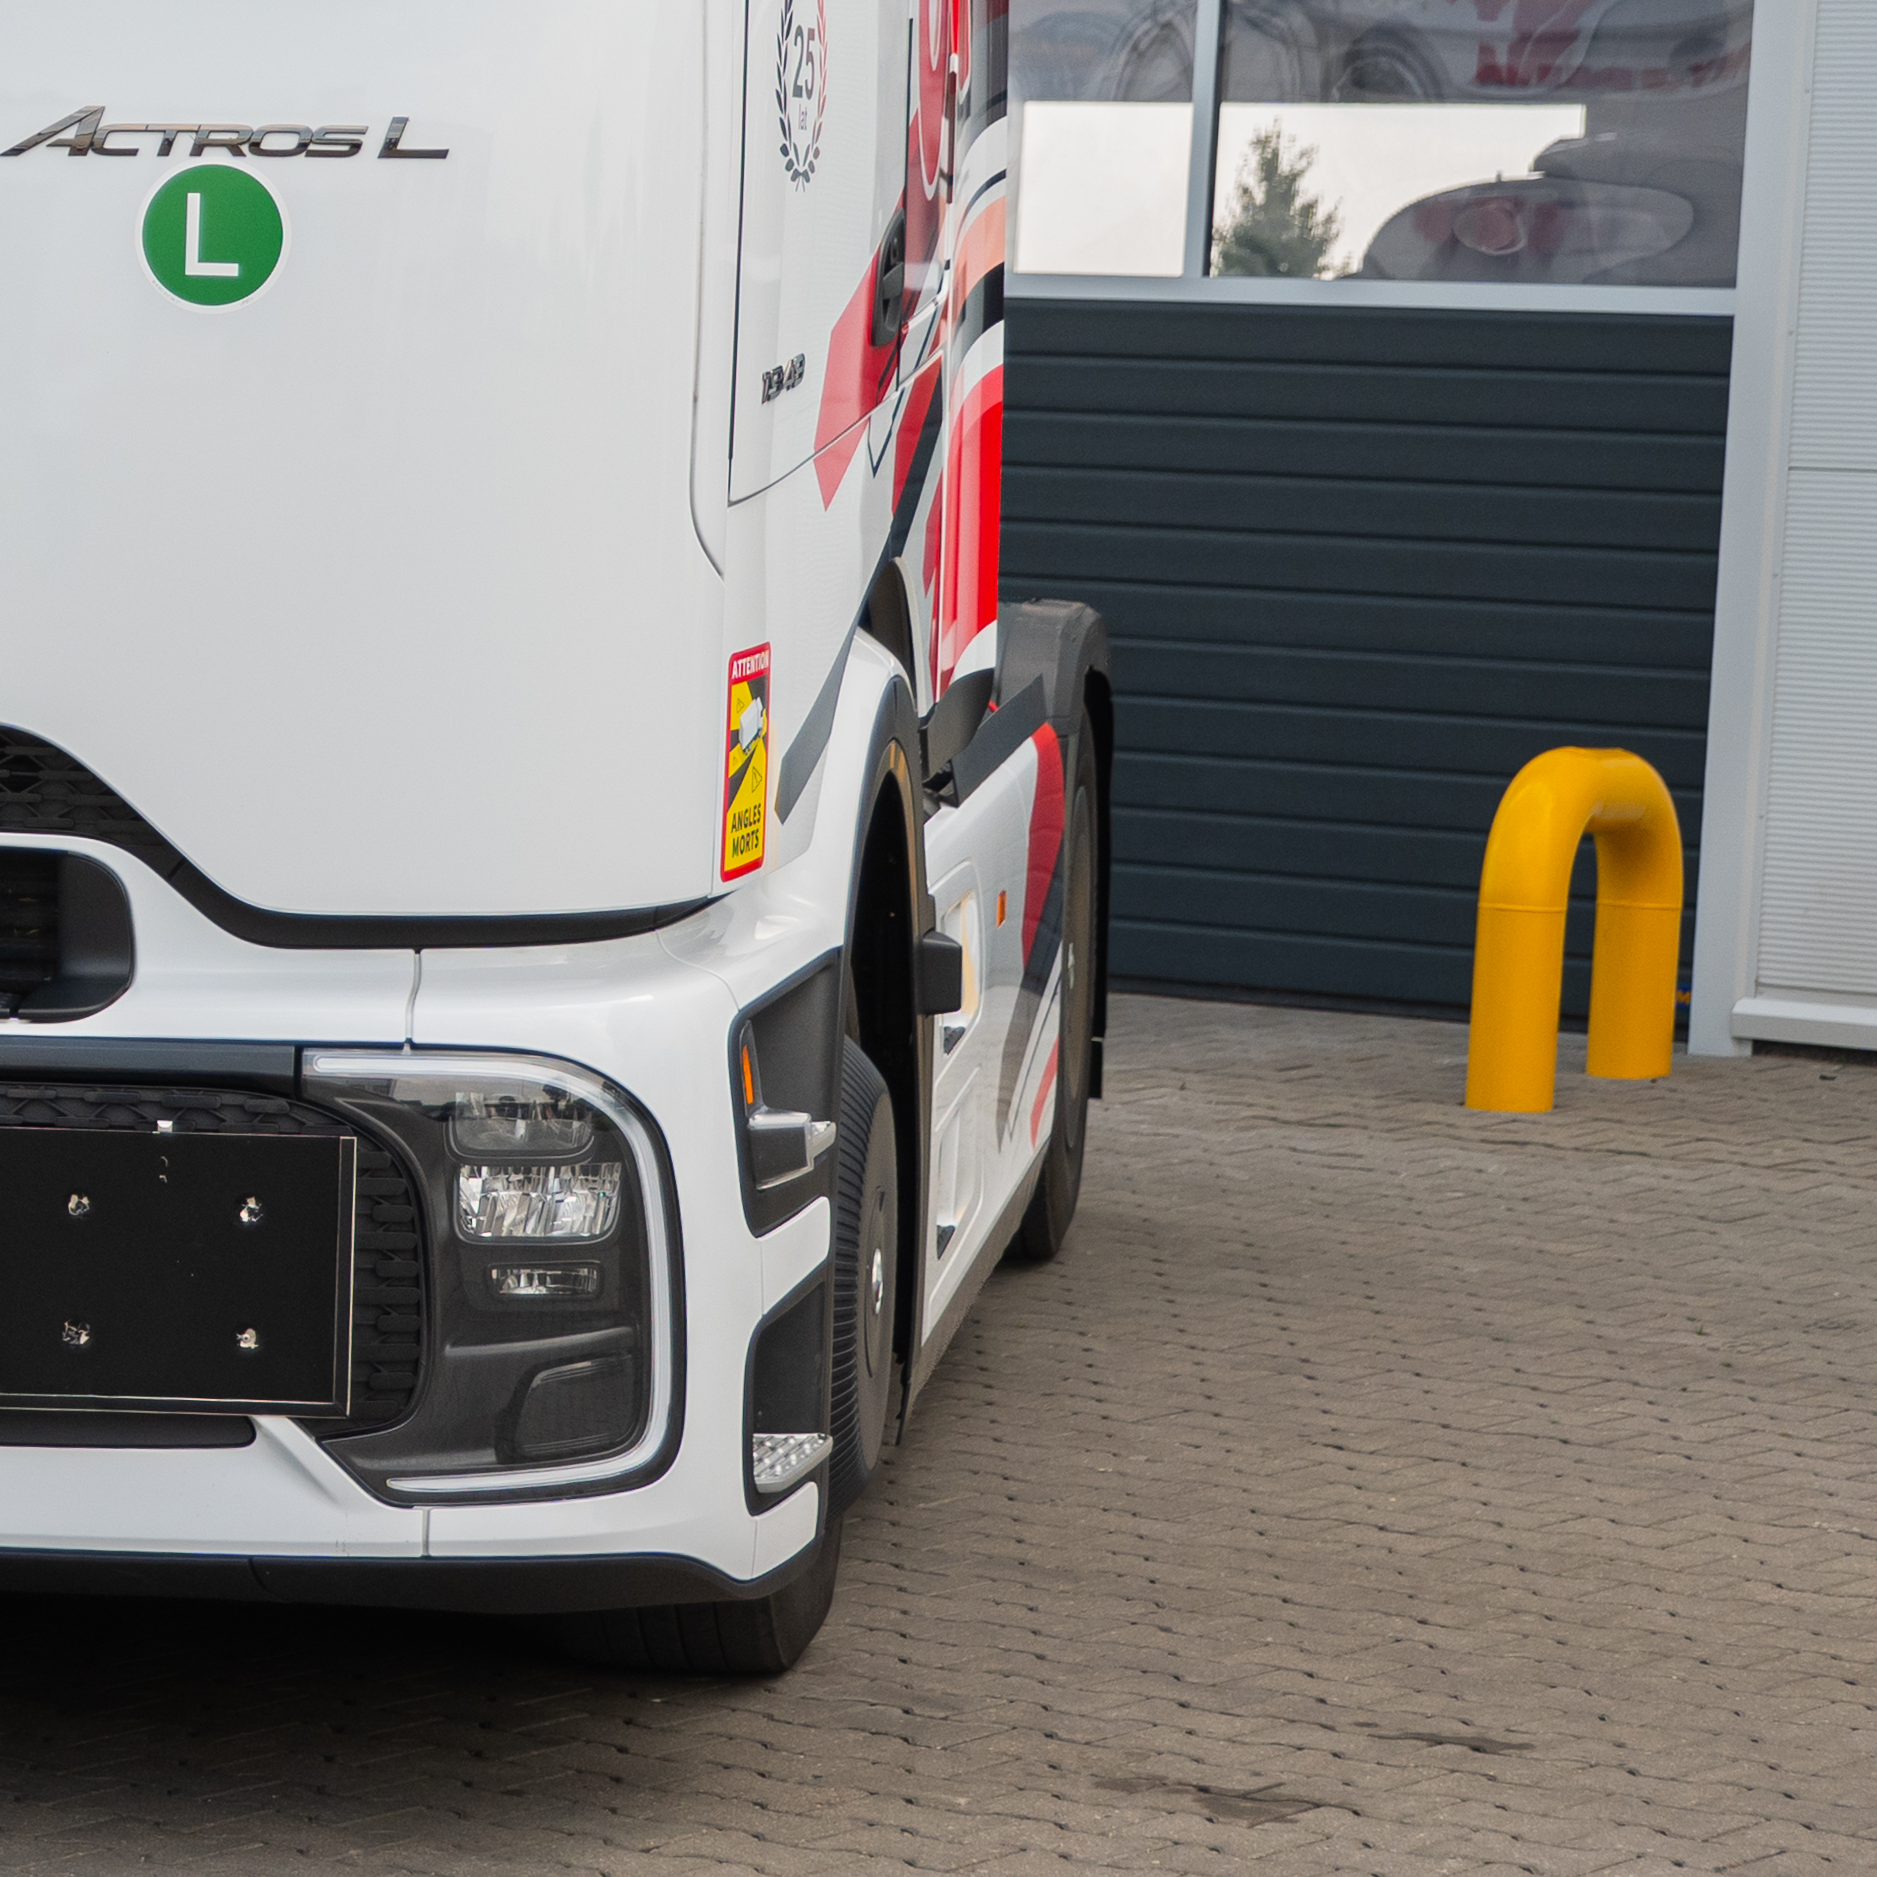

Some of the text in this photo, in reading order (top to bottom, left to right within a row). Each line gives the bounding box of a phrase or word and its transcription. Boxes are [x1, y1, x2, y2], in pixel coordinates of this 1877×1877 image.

[792, 24, 816, 101] 25
[376, 116, 451, 160] L
[184, 192, 240, 278] L
[731, 803, 762, 833] ANGLES
[731, 828, 760, 858] MORTS
